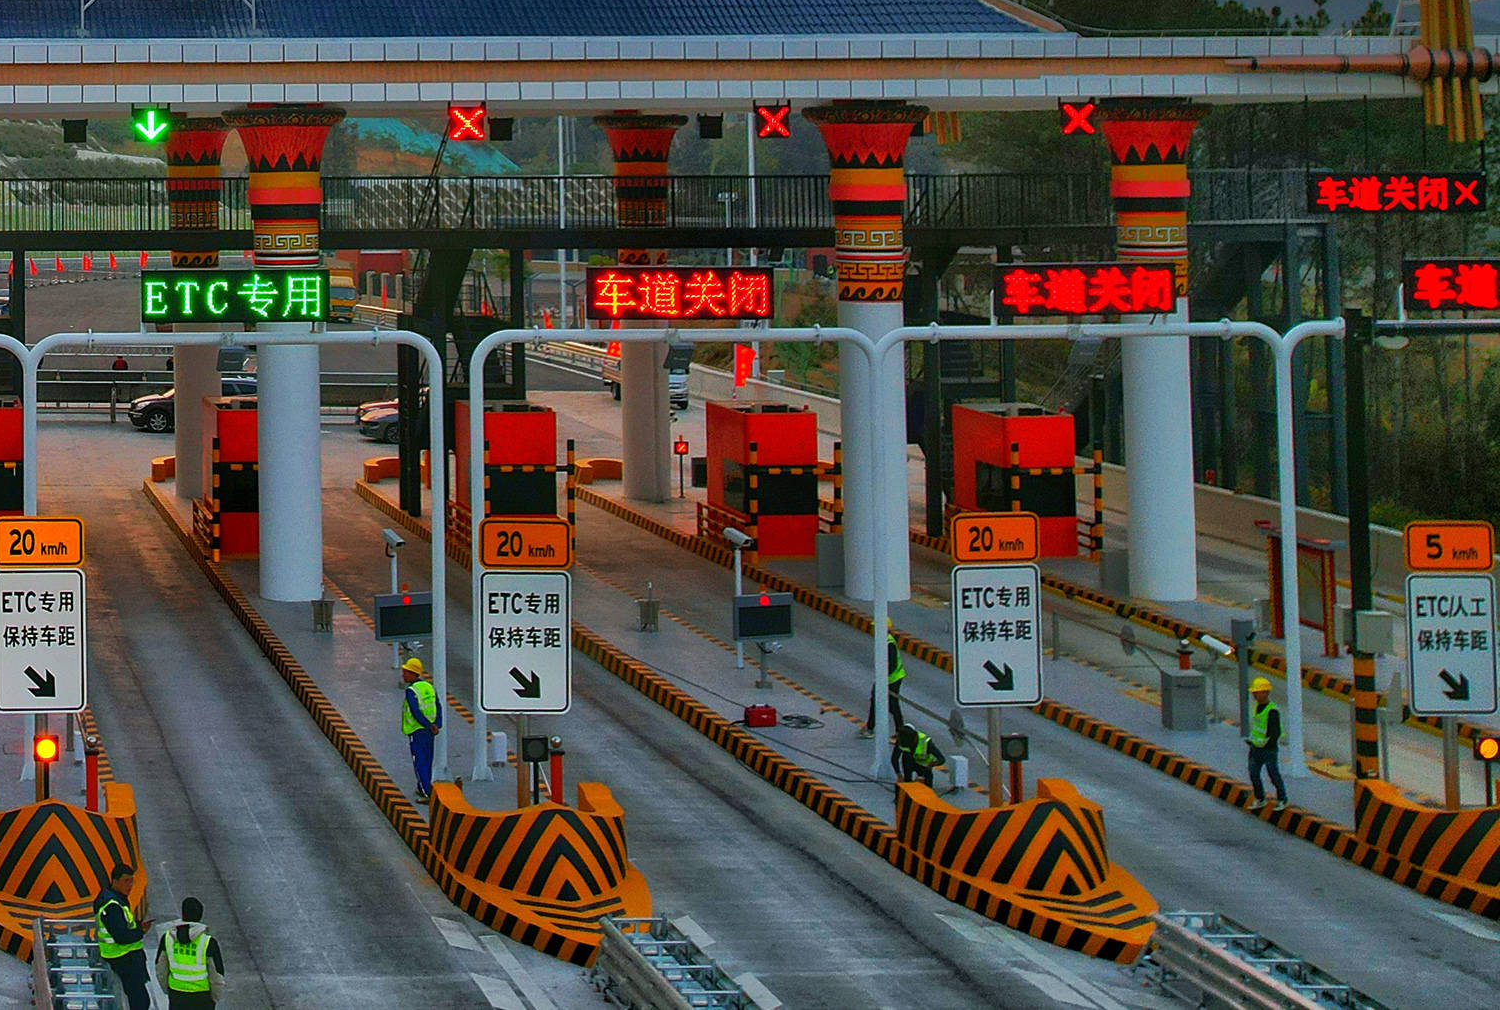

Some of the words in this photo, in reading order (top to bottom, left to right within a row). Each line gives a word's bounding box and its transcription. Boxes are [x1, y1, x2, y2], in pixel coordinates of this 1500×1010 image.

[1316, 176, 1448, 211] 车道关闭
[144, 274, 322, 318] ETC专用
[595, 271, 767, 316] 车道关闭
[1002, 266, 1172, 313] 车道关闭
[9, 529, 35, 555] 20
[41, 542, 67, 555] km/h
[496, 531, 523, 557] 20
[528, 544, 555, 558] km/h
[969, 526, 994, 552] 20
[999, 538, 1024, 552] km/h
[1426, 534, 1443, 559] 5
[1452, 547, 1478, 560] km/h
[2, 591, 74, 613] ETC专用
[488, 592, 560, 614] ETC专用
[961, 585, 1030, 609] ETC专用
[1415, 595, 1486, 618] ETC/人工
[3, 625, 76, 647] 保持车距
[489, 626, 561, 649] 保持车距
[963, 619, 1032, 642] 保持车距
[1418, 629, 1489, 652] 保持车距
